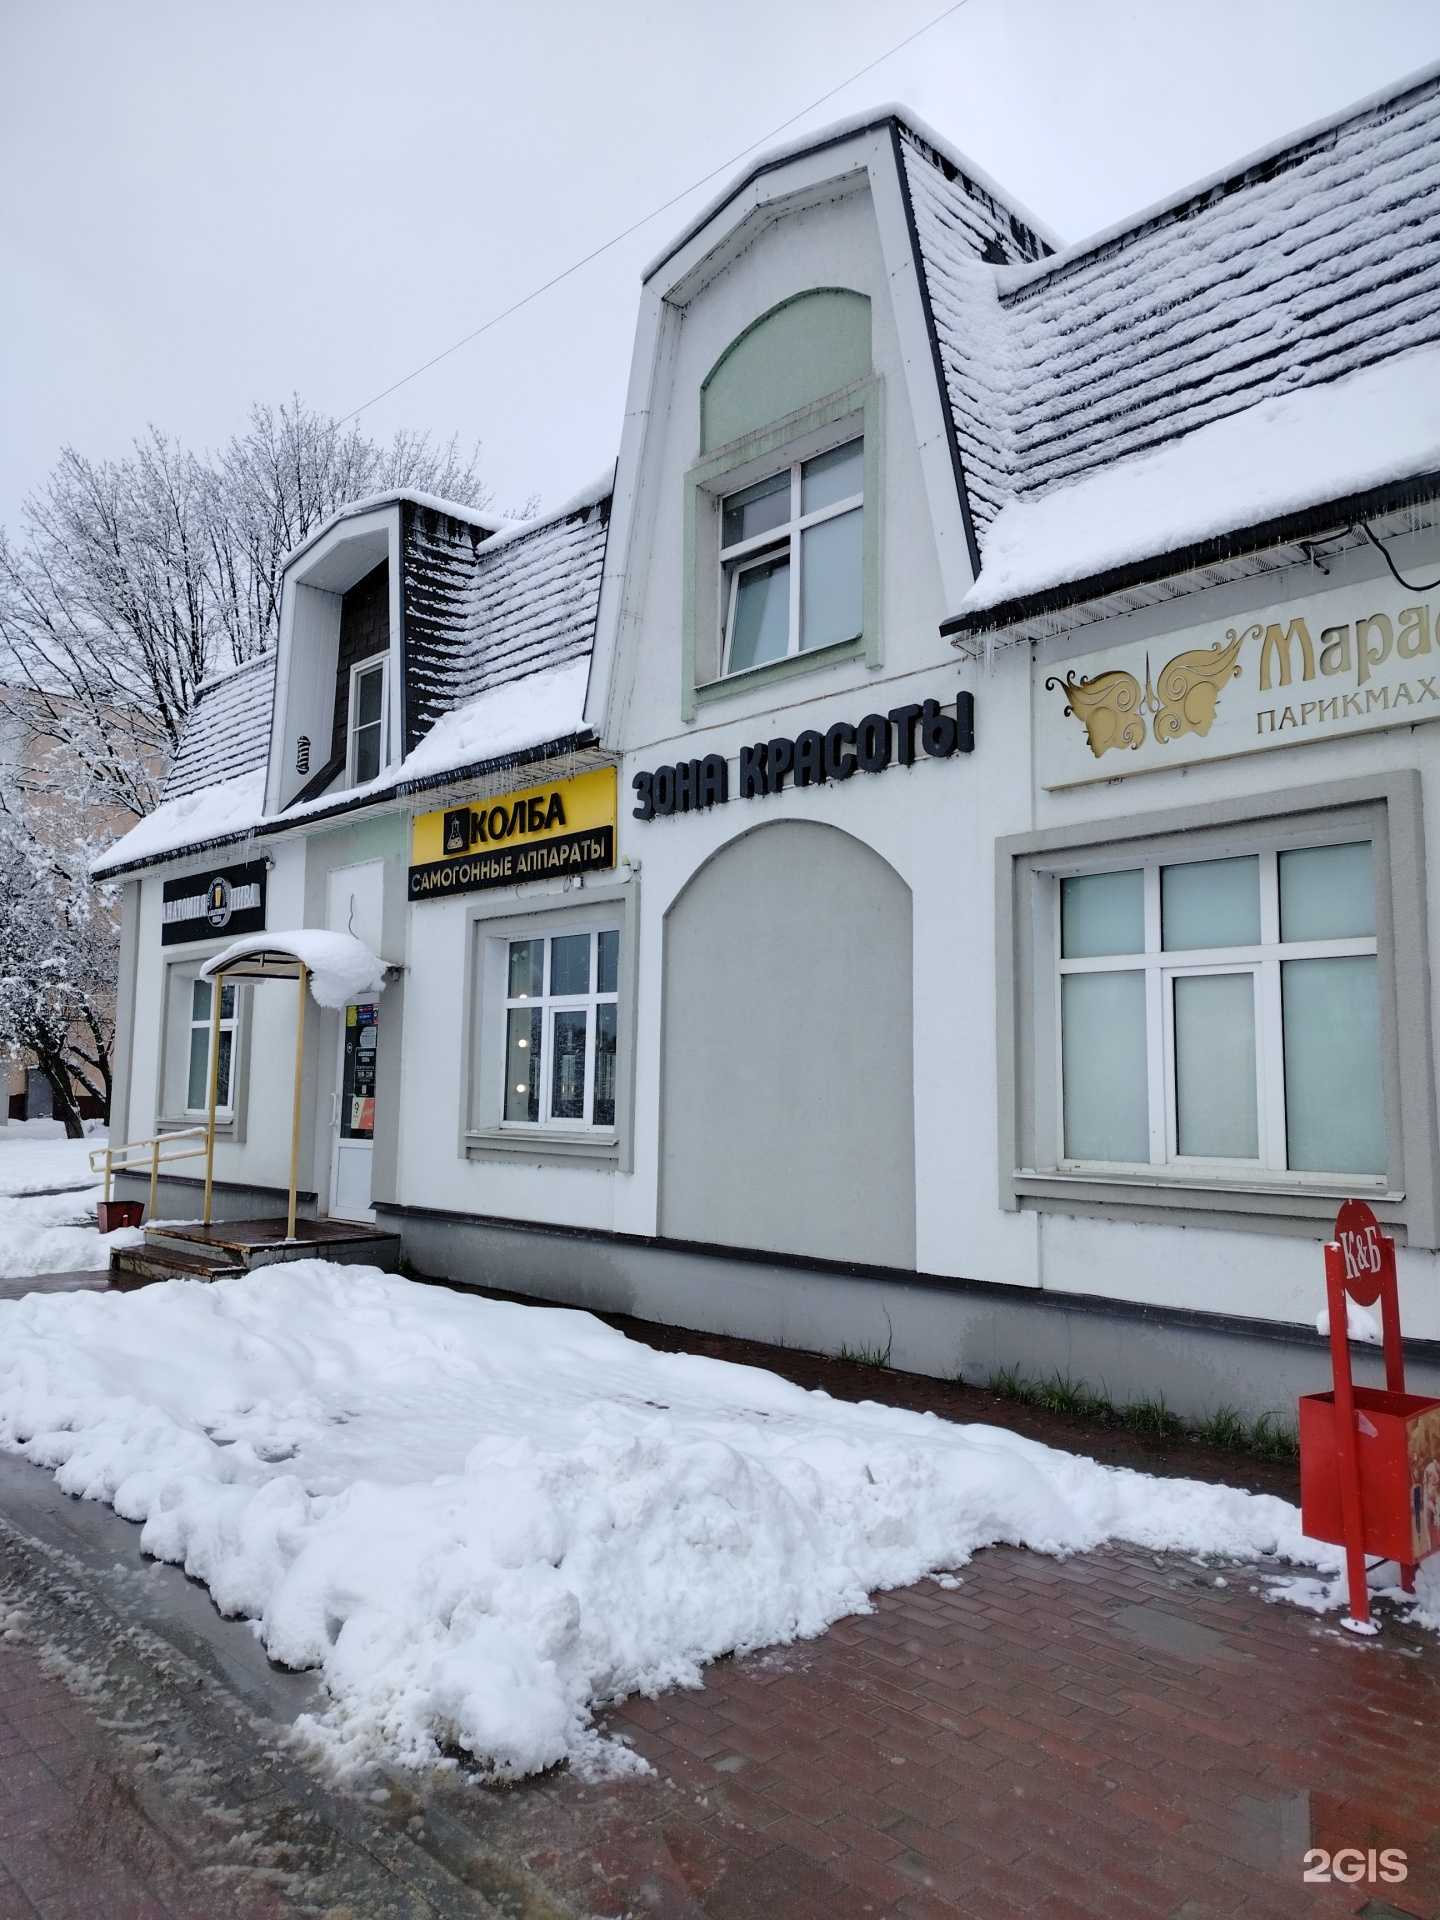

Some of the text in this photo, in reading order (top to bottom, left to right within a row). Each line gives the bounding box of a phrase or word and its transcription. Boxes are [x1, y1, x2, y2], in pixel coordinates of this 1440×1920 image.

[1259, 604, 1440, 691] Мара
[1256, 676, 1440, 735] ПАРИКМАХ
[631, 691, 976, 822] ЗОНА КРАСОТЫ
[470, 792, 567, 844] КОЛБА
[411, 836, 605, 892] САМОГОННЫЕ АППАРАТЫ
